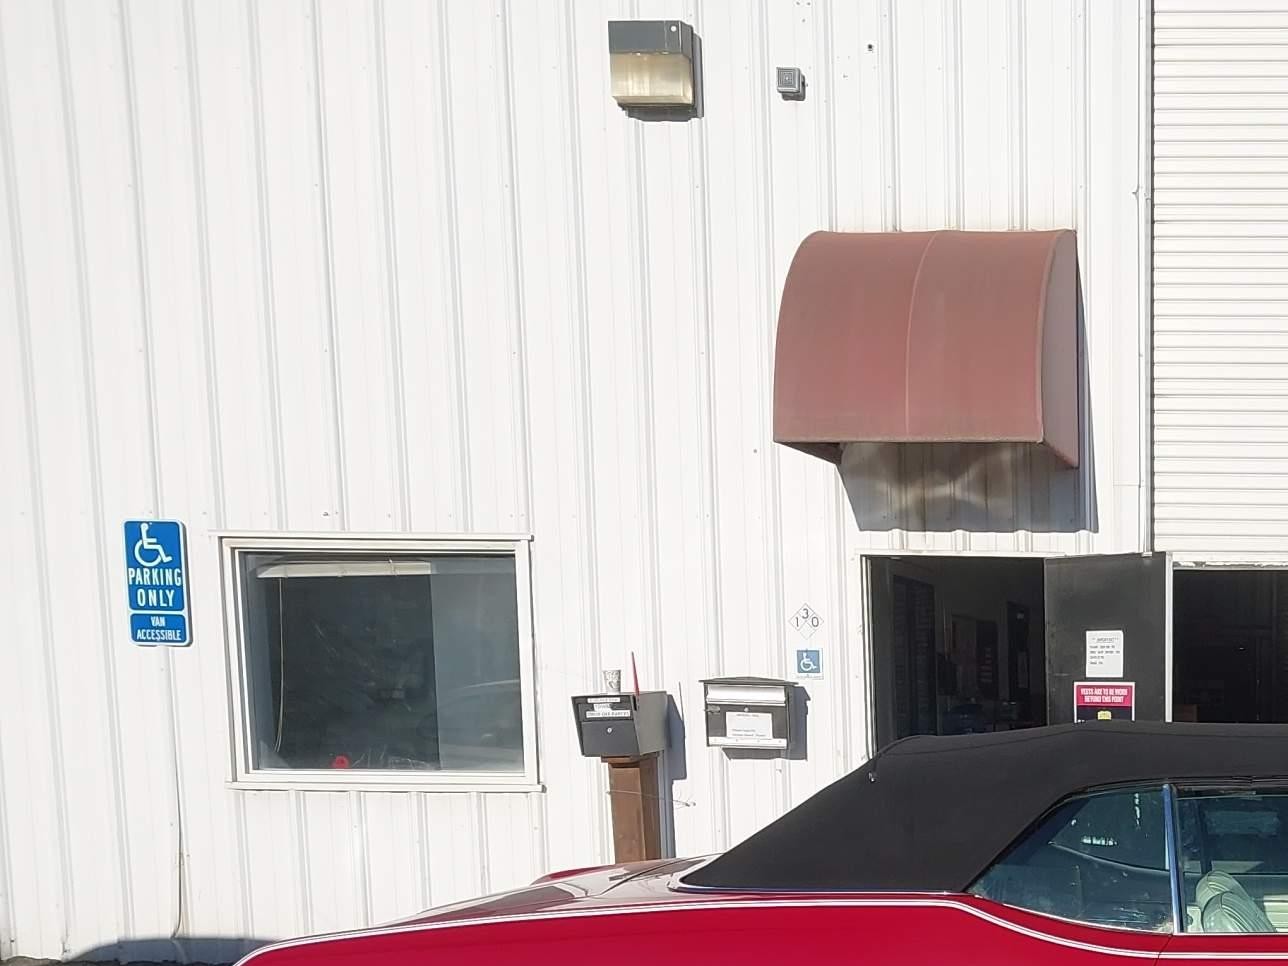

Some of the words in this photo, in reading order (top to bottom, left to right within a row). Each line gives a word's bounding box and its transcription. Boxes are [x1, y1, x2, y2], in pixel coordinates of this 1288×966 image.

[128, 567, 182, 586] PARKING
[137, 588, 175, 607] ONLY
[802, 608, 809, 619] 3
[150, 616, 166, 627] VAN
[811, 616, 819, 627] 0
[137, 629, 182, 641] ACCESSIBLE
